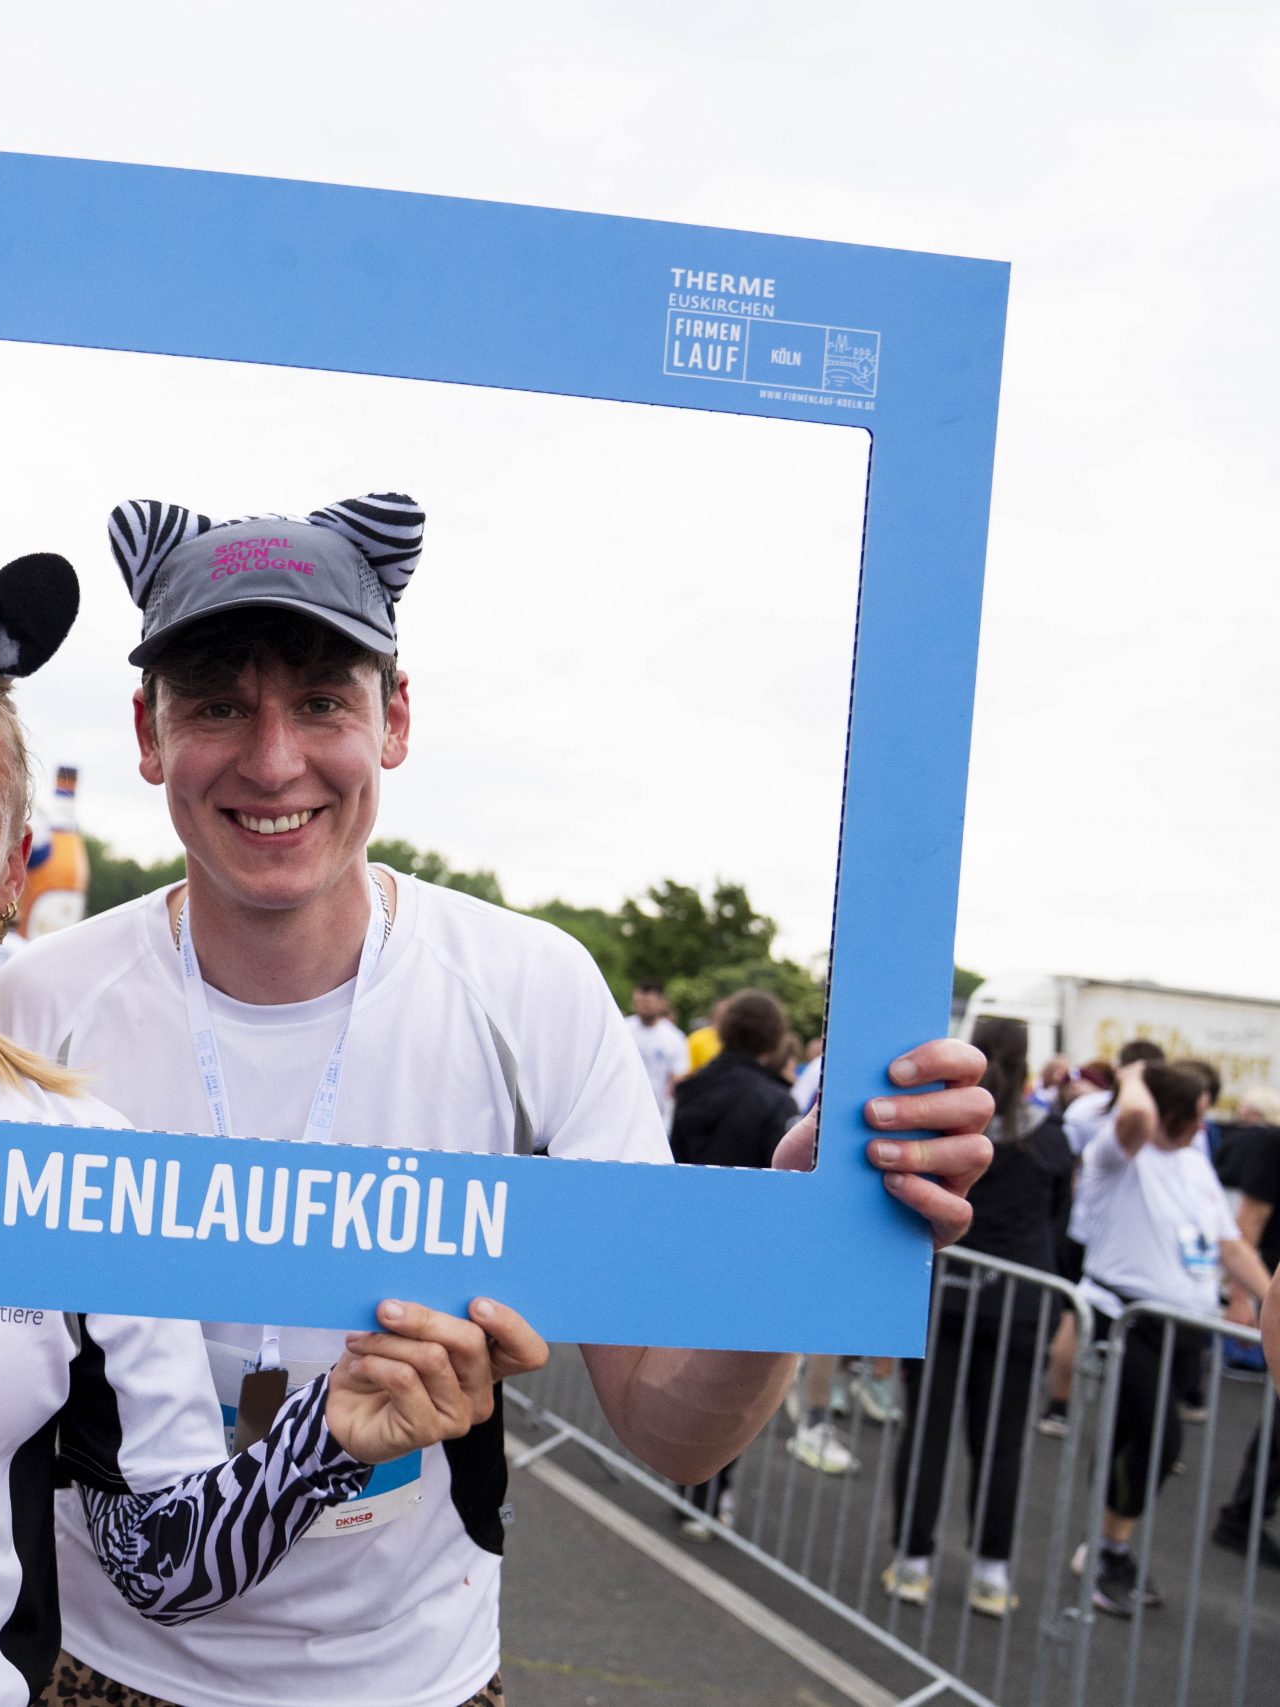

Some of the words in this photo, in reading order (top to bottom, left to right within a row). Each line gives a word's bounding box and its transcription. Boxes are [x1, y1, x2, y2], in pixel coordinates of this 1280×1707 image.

[671, 268, 775, 298] THERME
[668, 293, 776, 318] EUSKIRCHEN
[675, 317, 742, 342] FIRMEN
[673, 340, 739, 373] LAUF
[771, 347, 802, 366] KÖLN
[214, 537, 294, 557] SOCIAL
[216, 547, 270, 567] RUN
[210, 558, 315, 581] COLOGNE
[336, 1515, 366, 1526] DKMS
